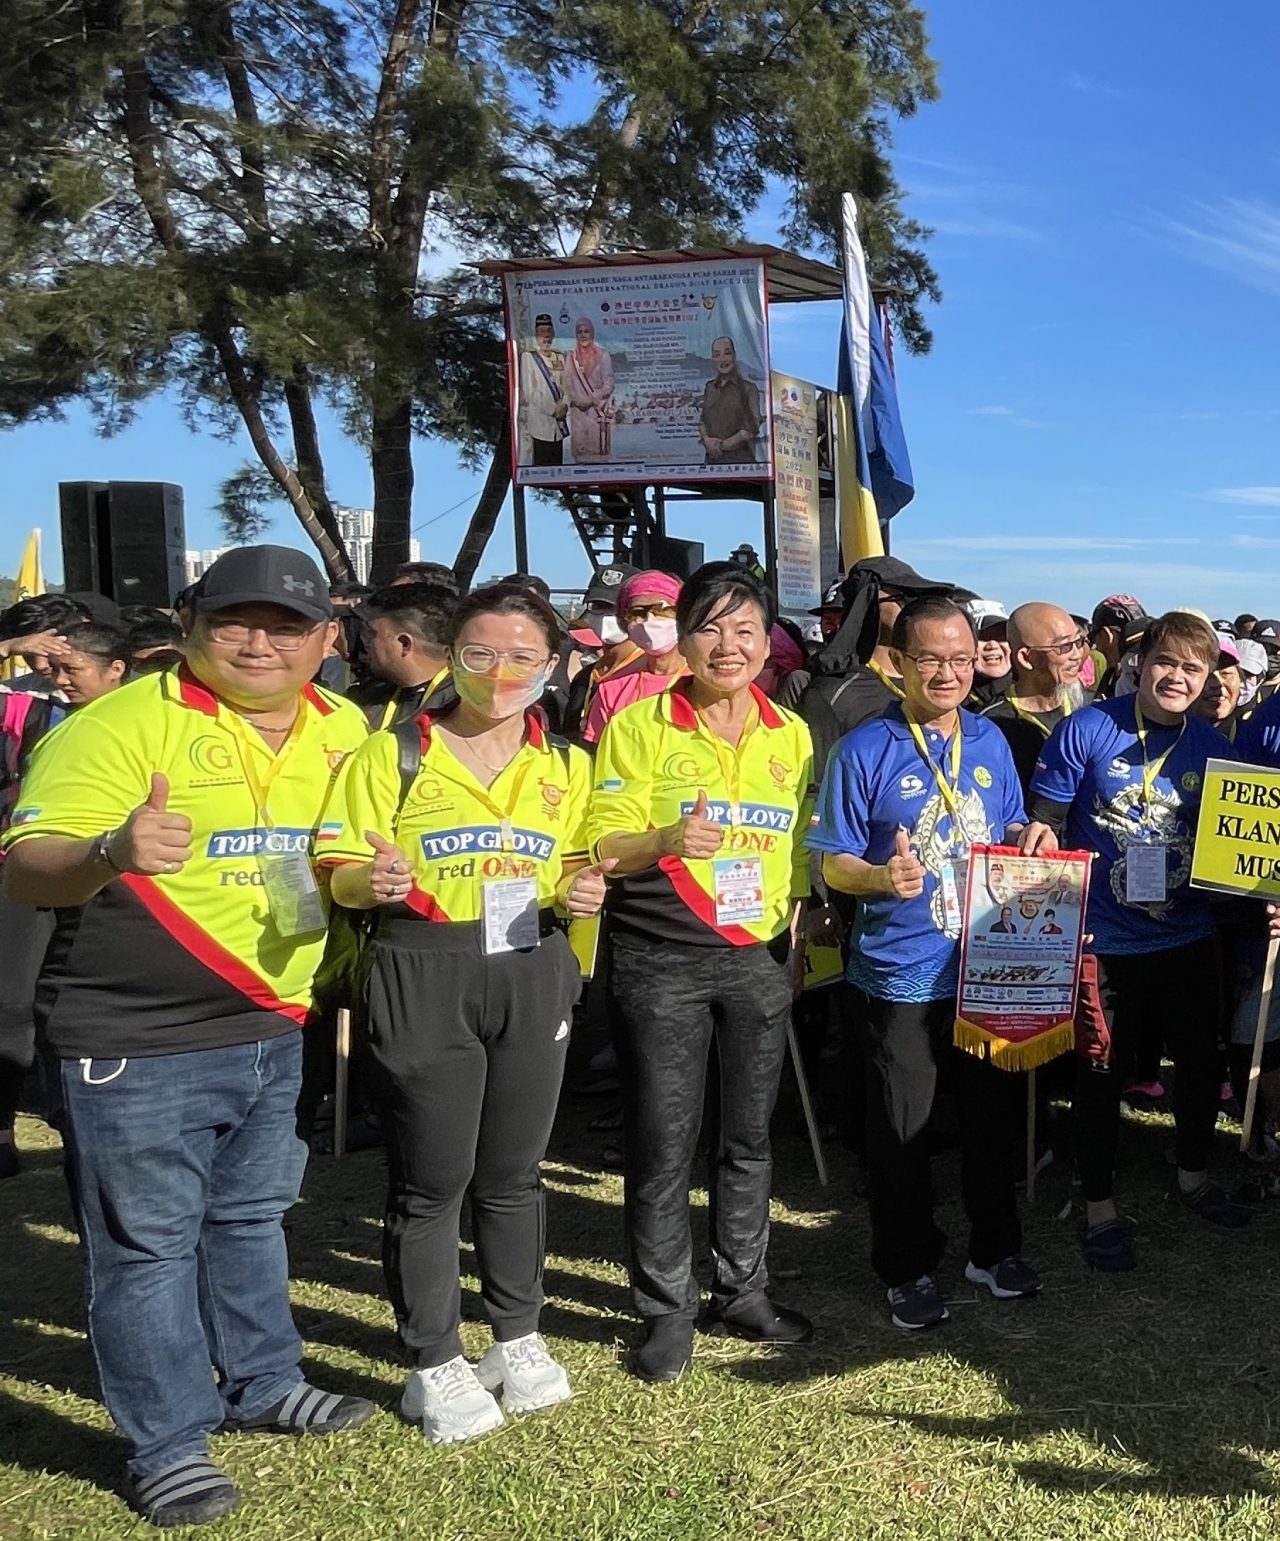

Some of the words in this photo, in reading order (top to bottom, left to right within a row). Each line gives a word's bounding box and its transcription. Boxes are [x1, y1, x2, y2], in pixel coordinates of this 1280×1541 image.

[214, 834, 262, 854] TOP
[265, 833, 309, 853] GLO
[424, 833, 475, 856] TOP
[731, 831, 778, 853] ONE
[437, 858, 476, 881] red
